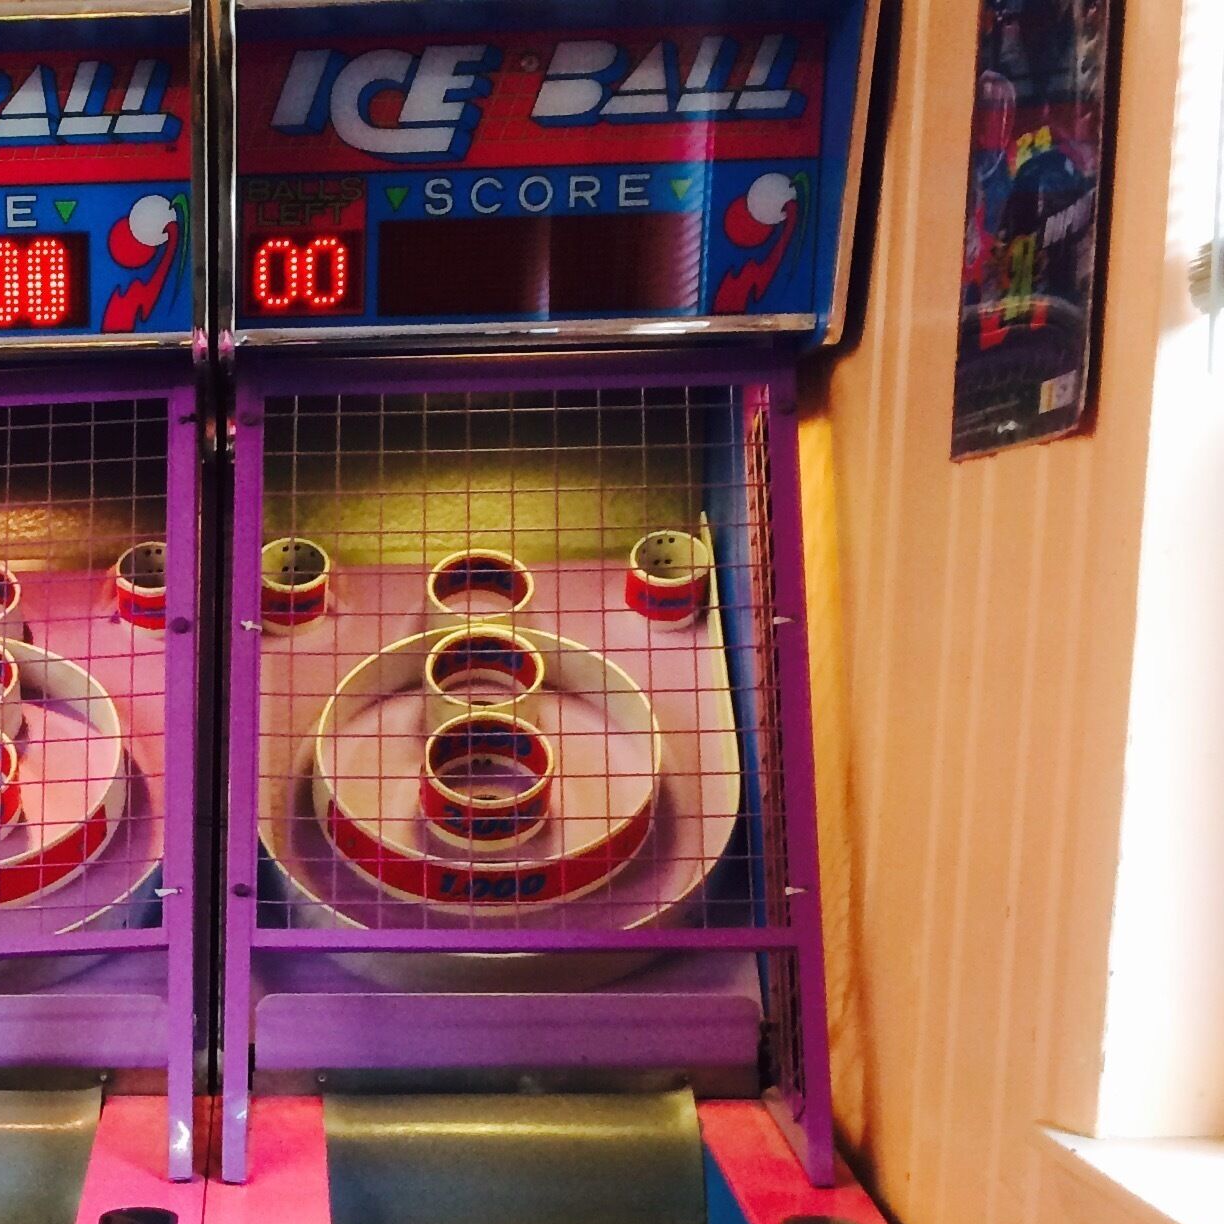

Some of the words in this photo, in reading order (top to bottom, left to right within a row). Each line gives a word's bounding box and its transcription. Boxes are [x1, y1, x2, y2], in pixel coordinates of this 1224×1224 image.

[271, 44, 493, 160] ICE
[530, 34, 802, 123] BALL
[248, 177, 364, 200] BALLS
[424, 173, 651, 216] SCORE
[256, 203, 346, 226] LEFT
[257, 237, 346, 306] 00
